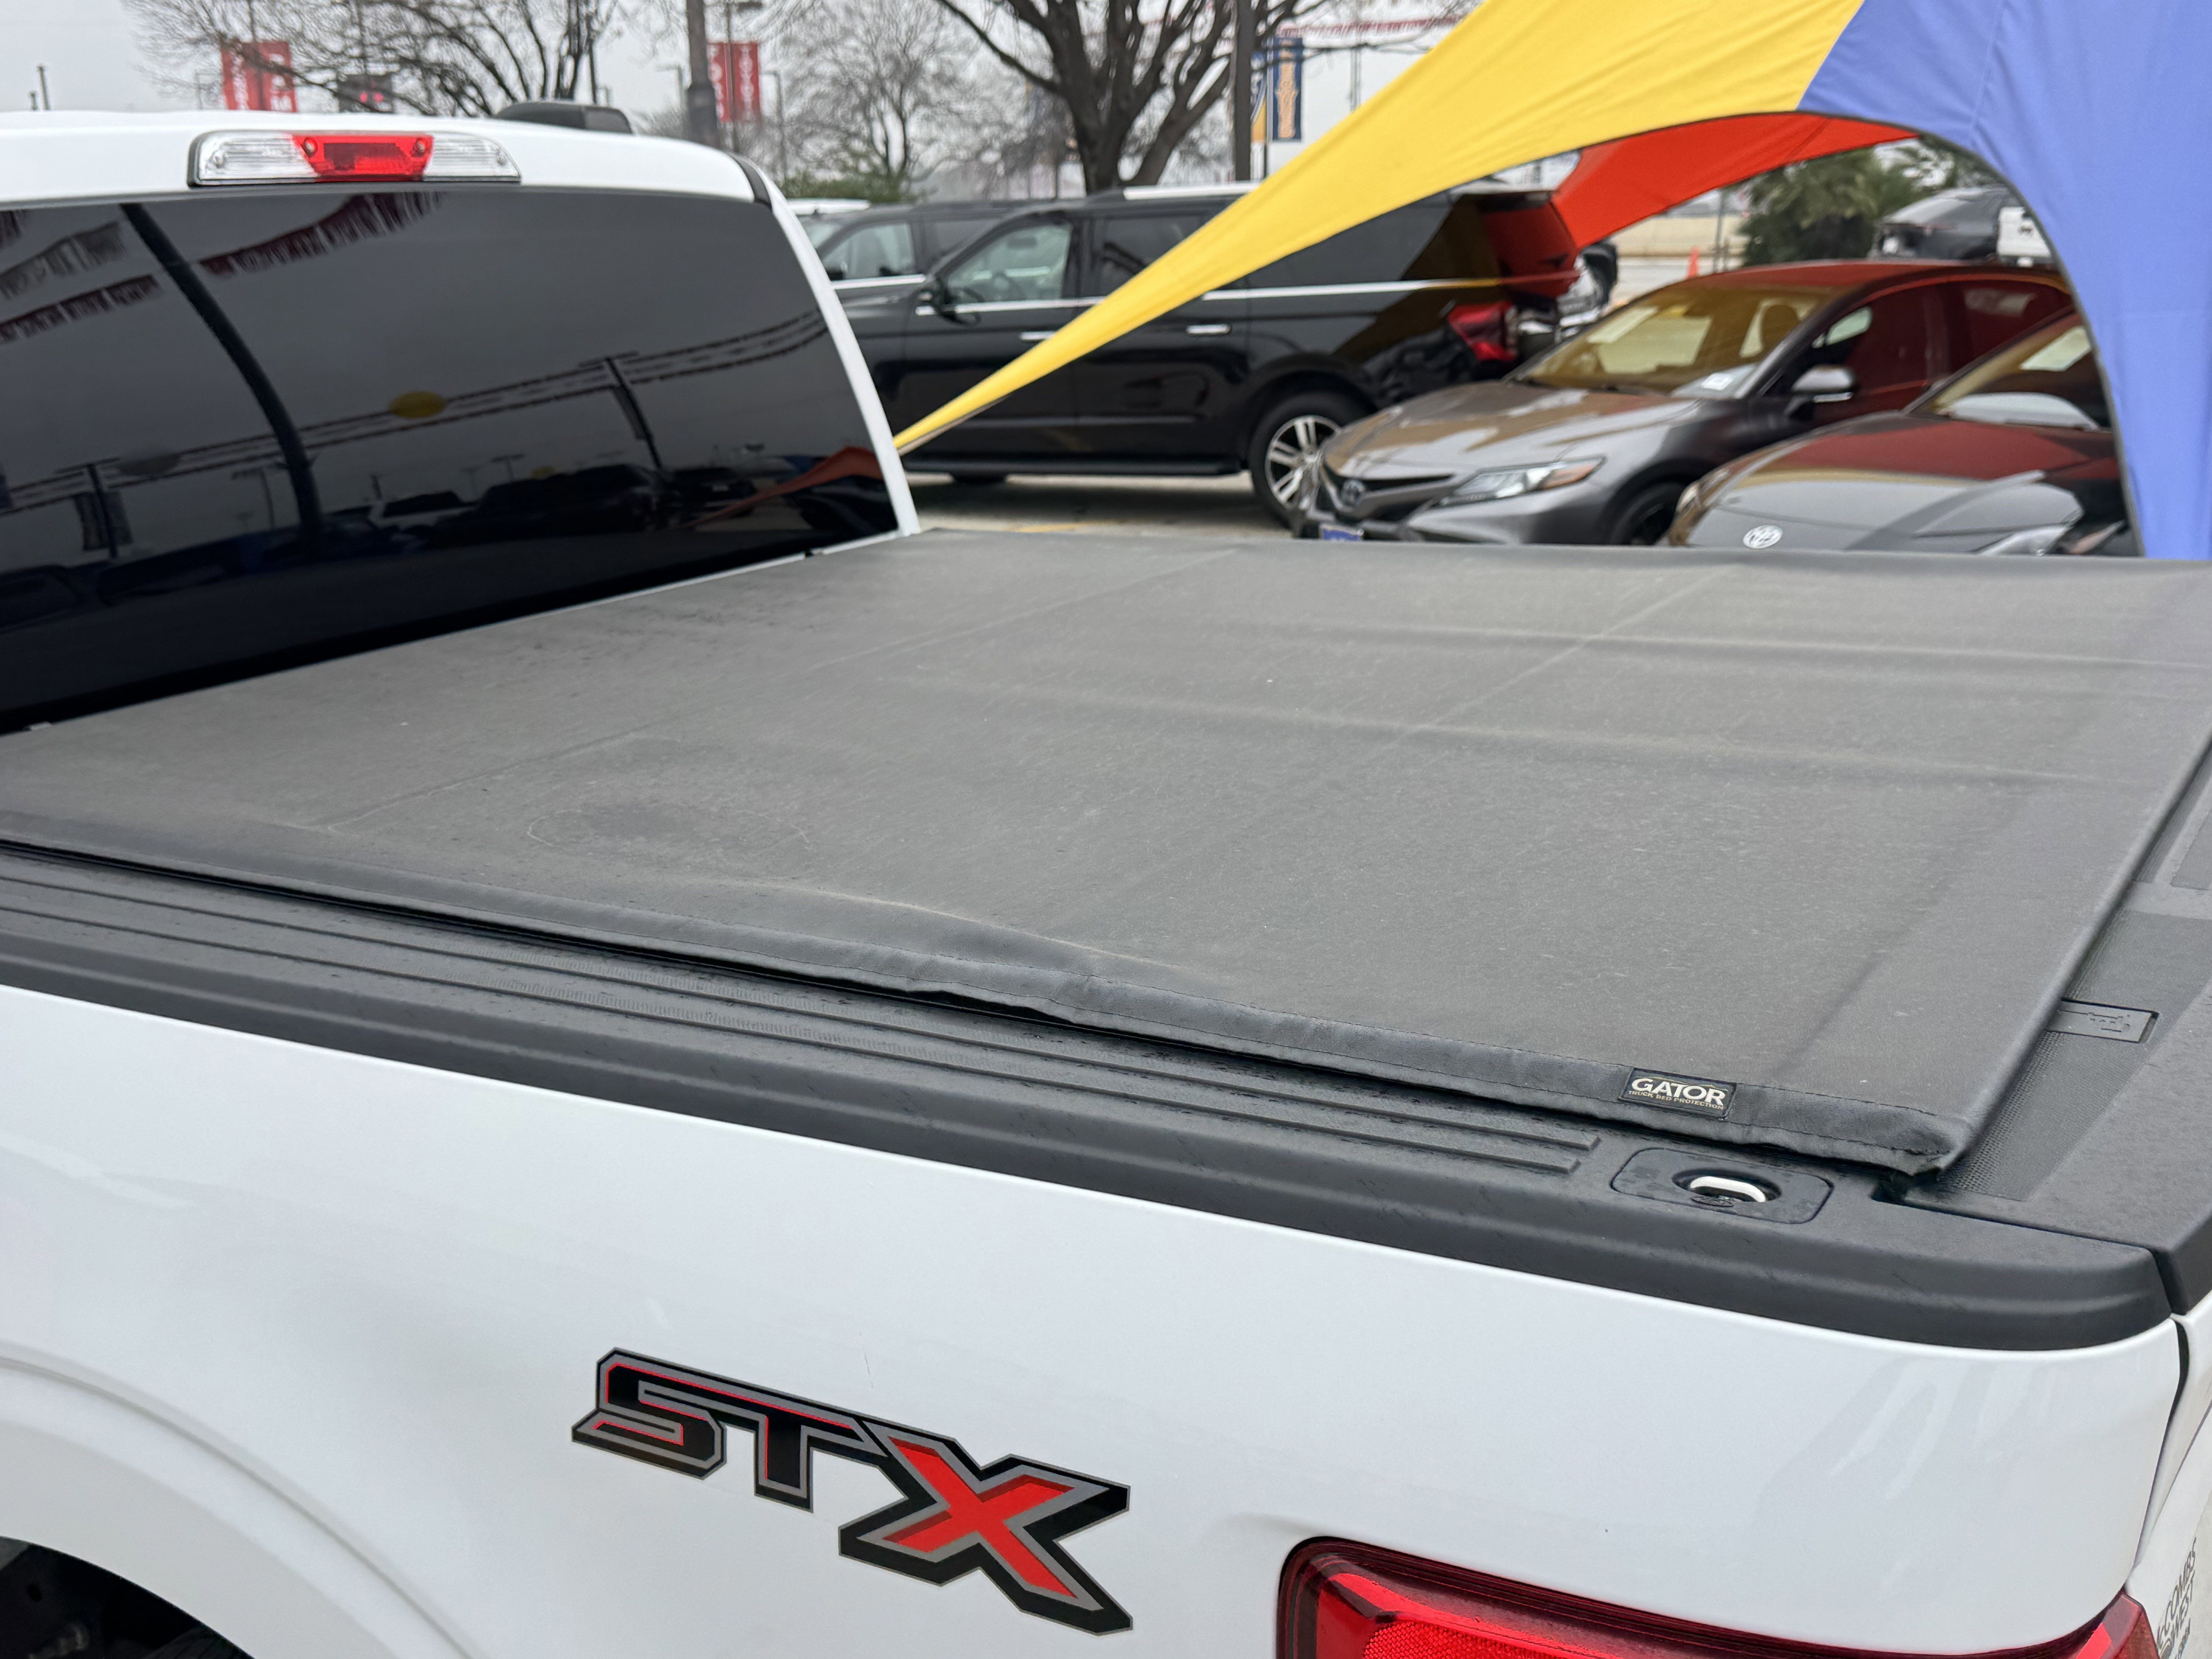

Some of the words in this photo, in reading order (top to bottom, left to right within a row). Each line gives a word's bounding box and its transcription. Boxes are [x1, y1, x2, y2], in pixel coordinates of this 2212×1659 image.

[1632, 1078, 1725, 1106] GATOR
[1673, 1097, 1724, 1110] PROTECTION
[571, 1347, 1133, 1635] STX
